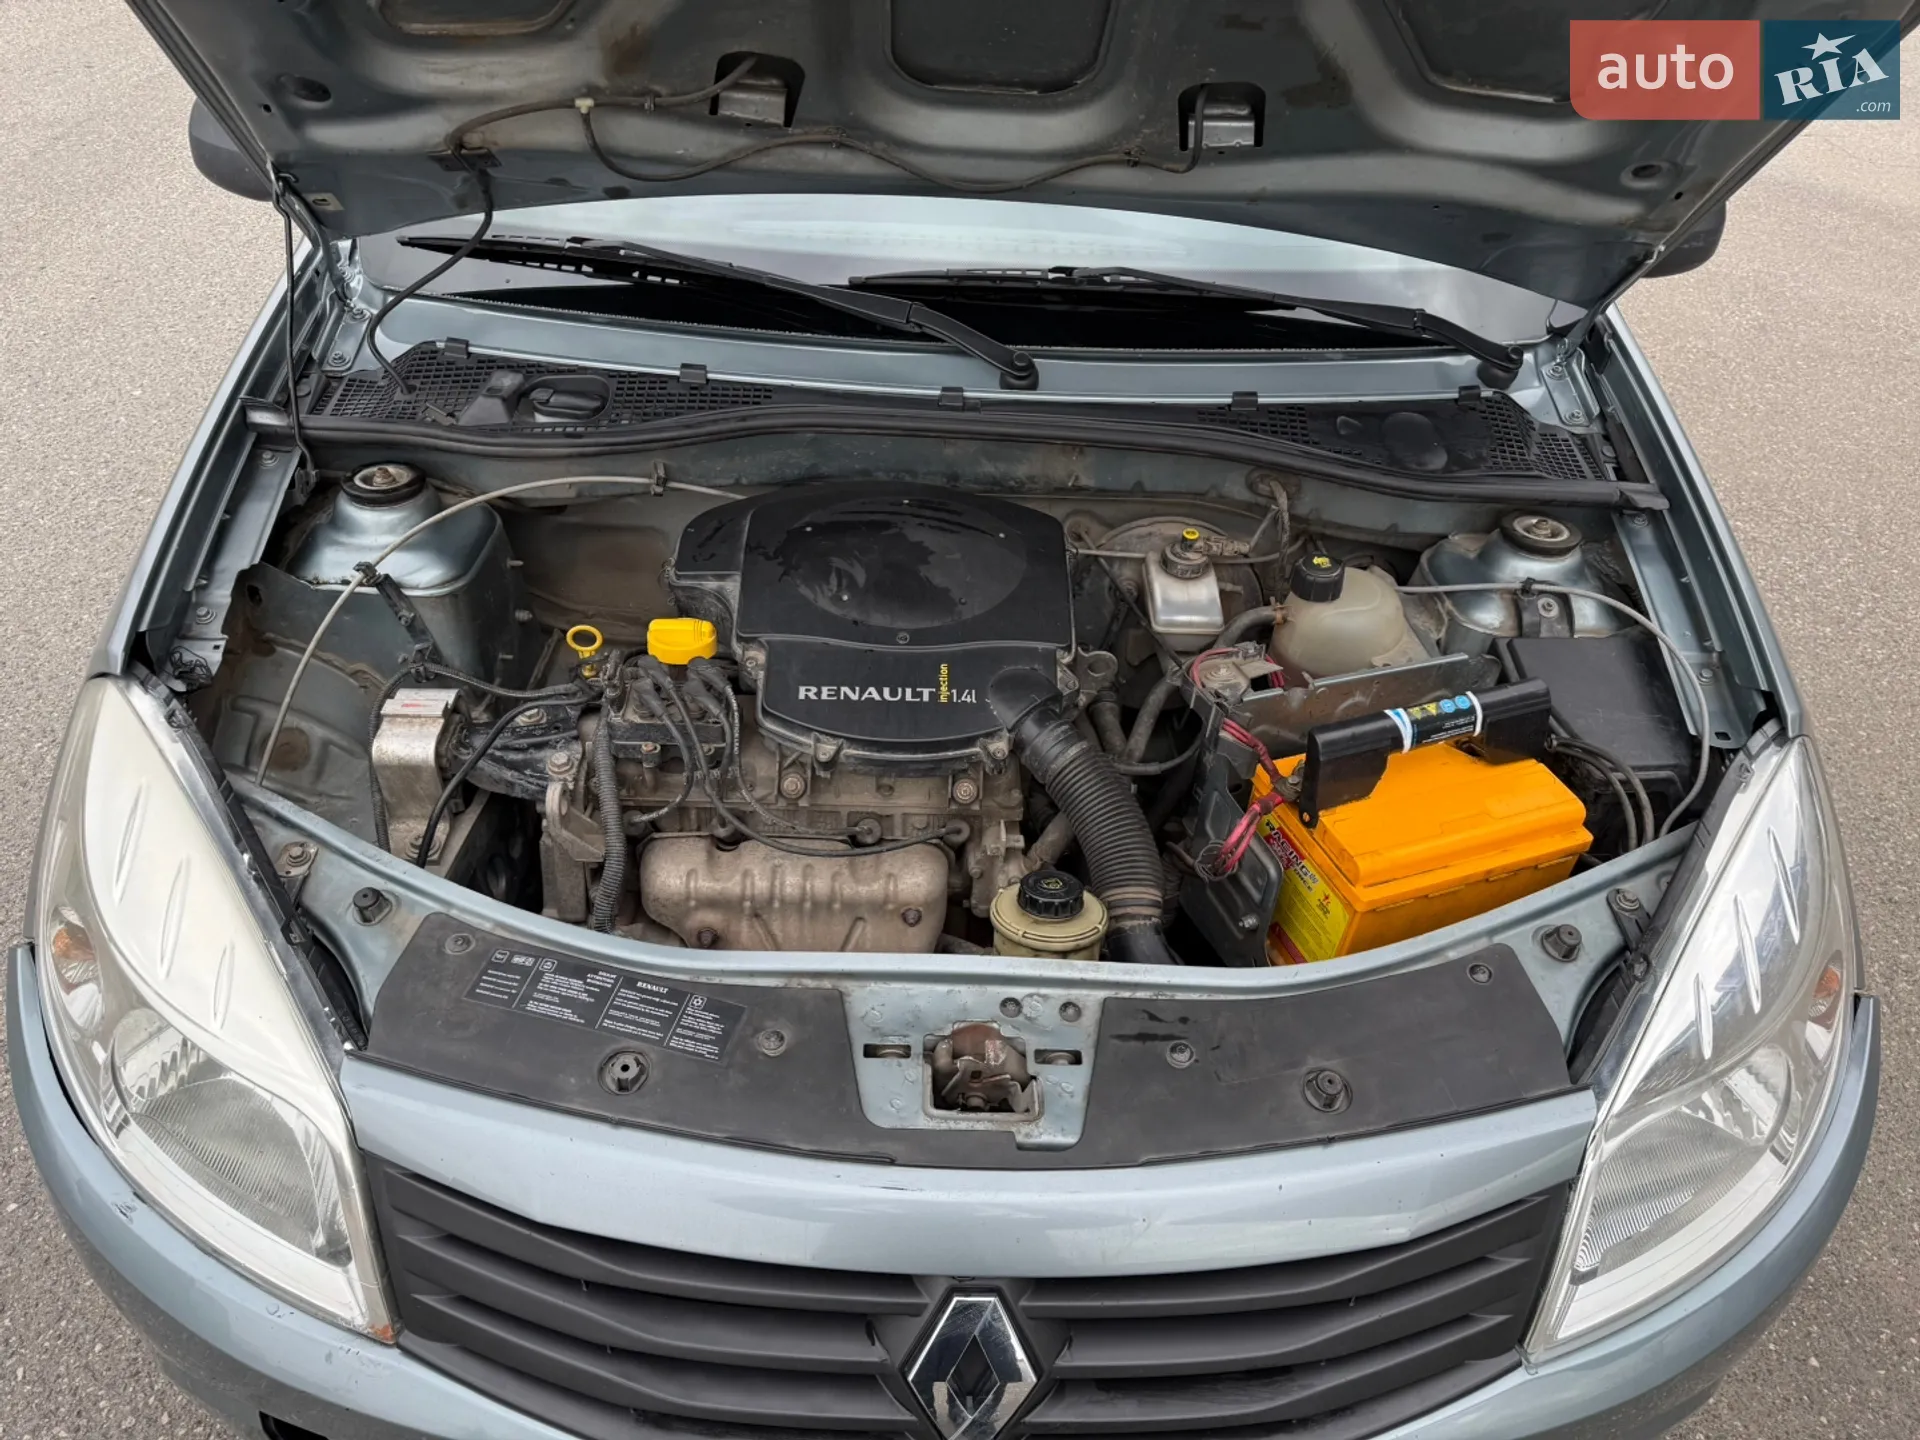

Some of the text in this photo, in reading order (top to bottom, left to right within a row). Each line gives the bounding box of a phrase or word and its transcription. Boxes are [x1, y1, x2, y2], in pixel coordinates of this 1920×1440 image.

[798, 685, 936, 702] RENAULT
[938, 663, 948, 703] injection
[1265, 819, 1309, 877] RACING
[636, 981, 669, 994] RENAULT
